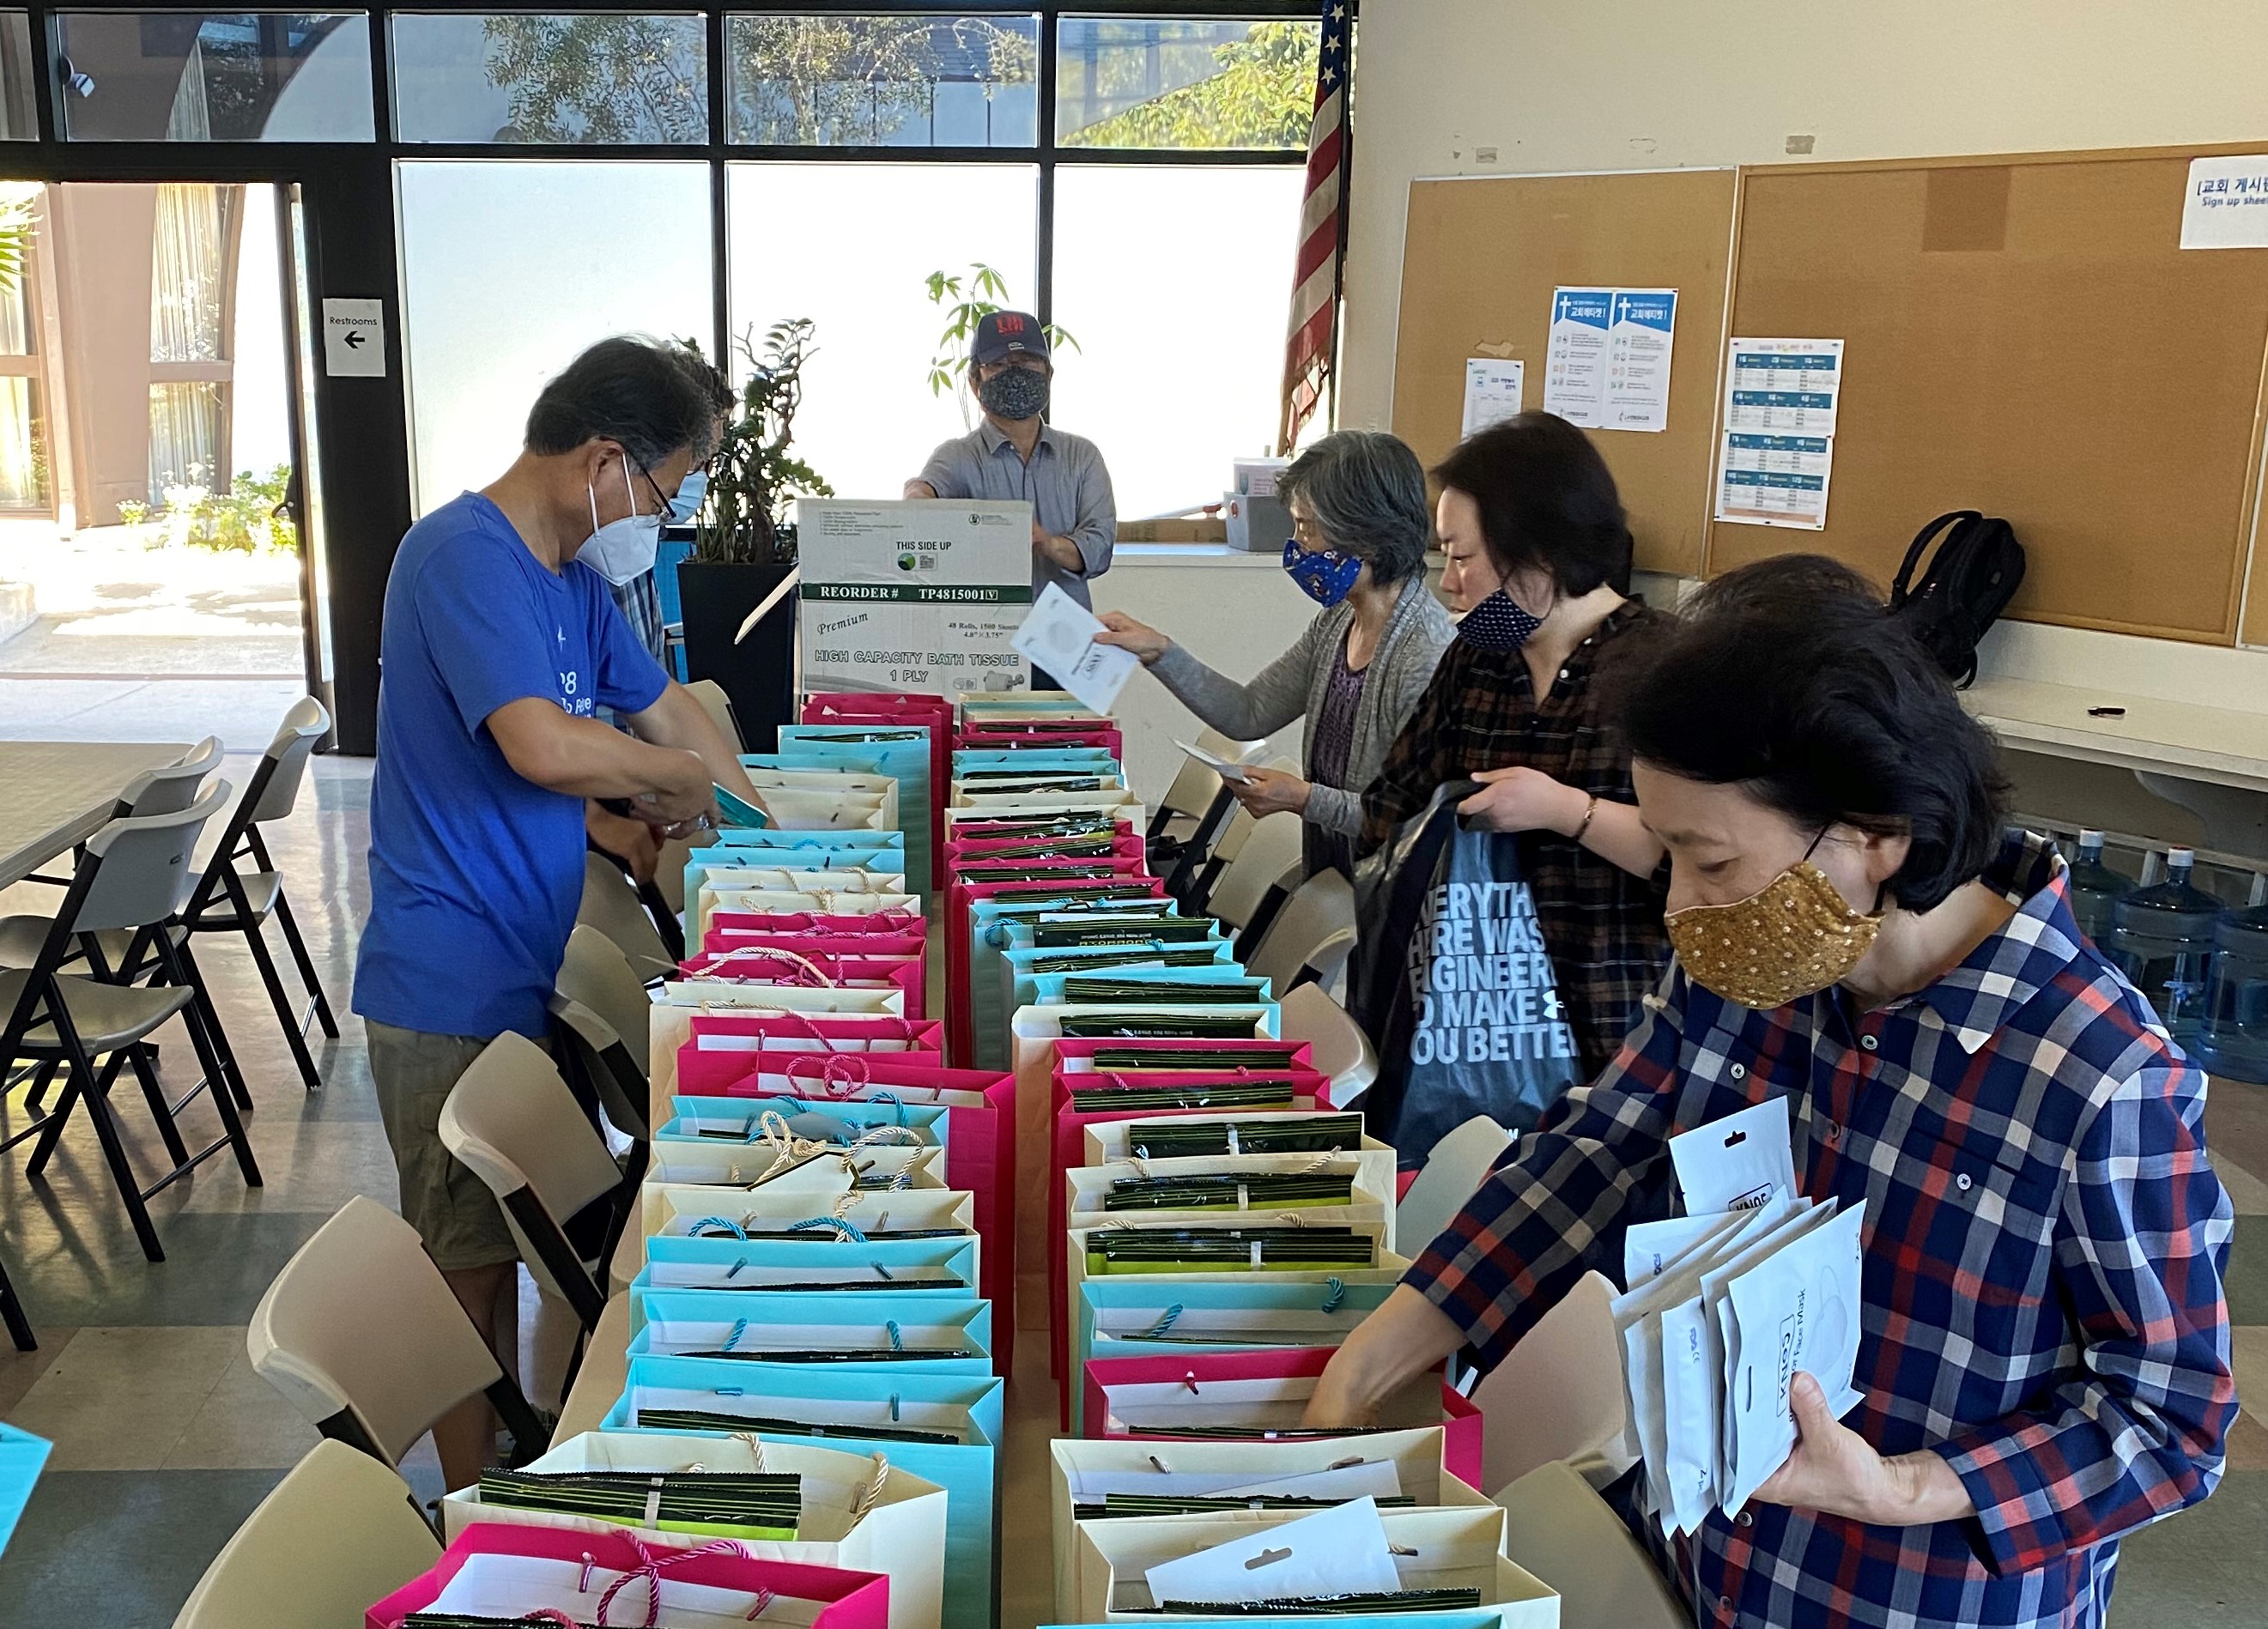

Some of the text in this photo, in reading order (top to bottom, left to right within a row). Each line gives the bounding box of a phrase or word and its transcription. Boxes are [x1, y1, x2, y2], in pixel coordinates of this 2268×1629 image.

[2202, 197, 2223, 208] Sign
[2227, 197, 2240, 208] up
[330, 316, 378, 326] Restrooms
[896, 541, 952, 551] THIS SIDE UP
[821, 586, 889, 598] REORDER
[816, 612, 869, 635] Premium
[815, 650, 1019, 666] HIGH CAPACITY BATH TISSUE
[890, 669, 929, 682] 1 PLY
[1480, 917, 1546, 955] WAS
[1441, 988, 1538, 1027] MAKE
[1797, 1287, 1806, 1326] Mask
[1792, 1327, 1804, 1356] Face
